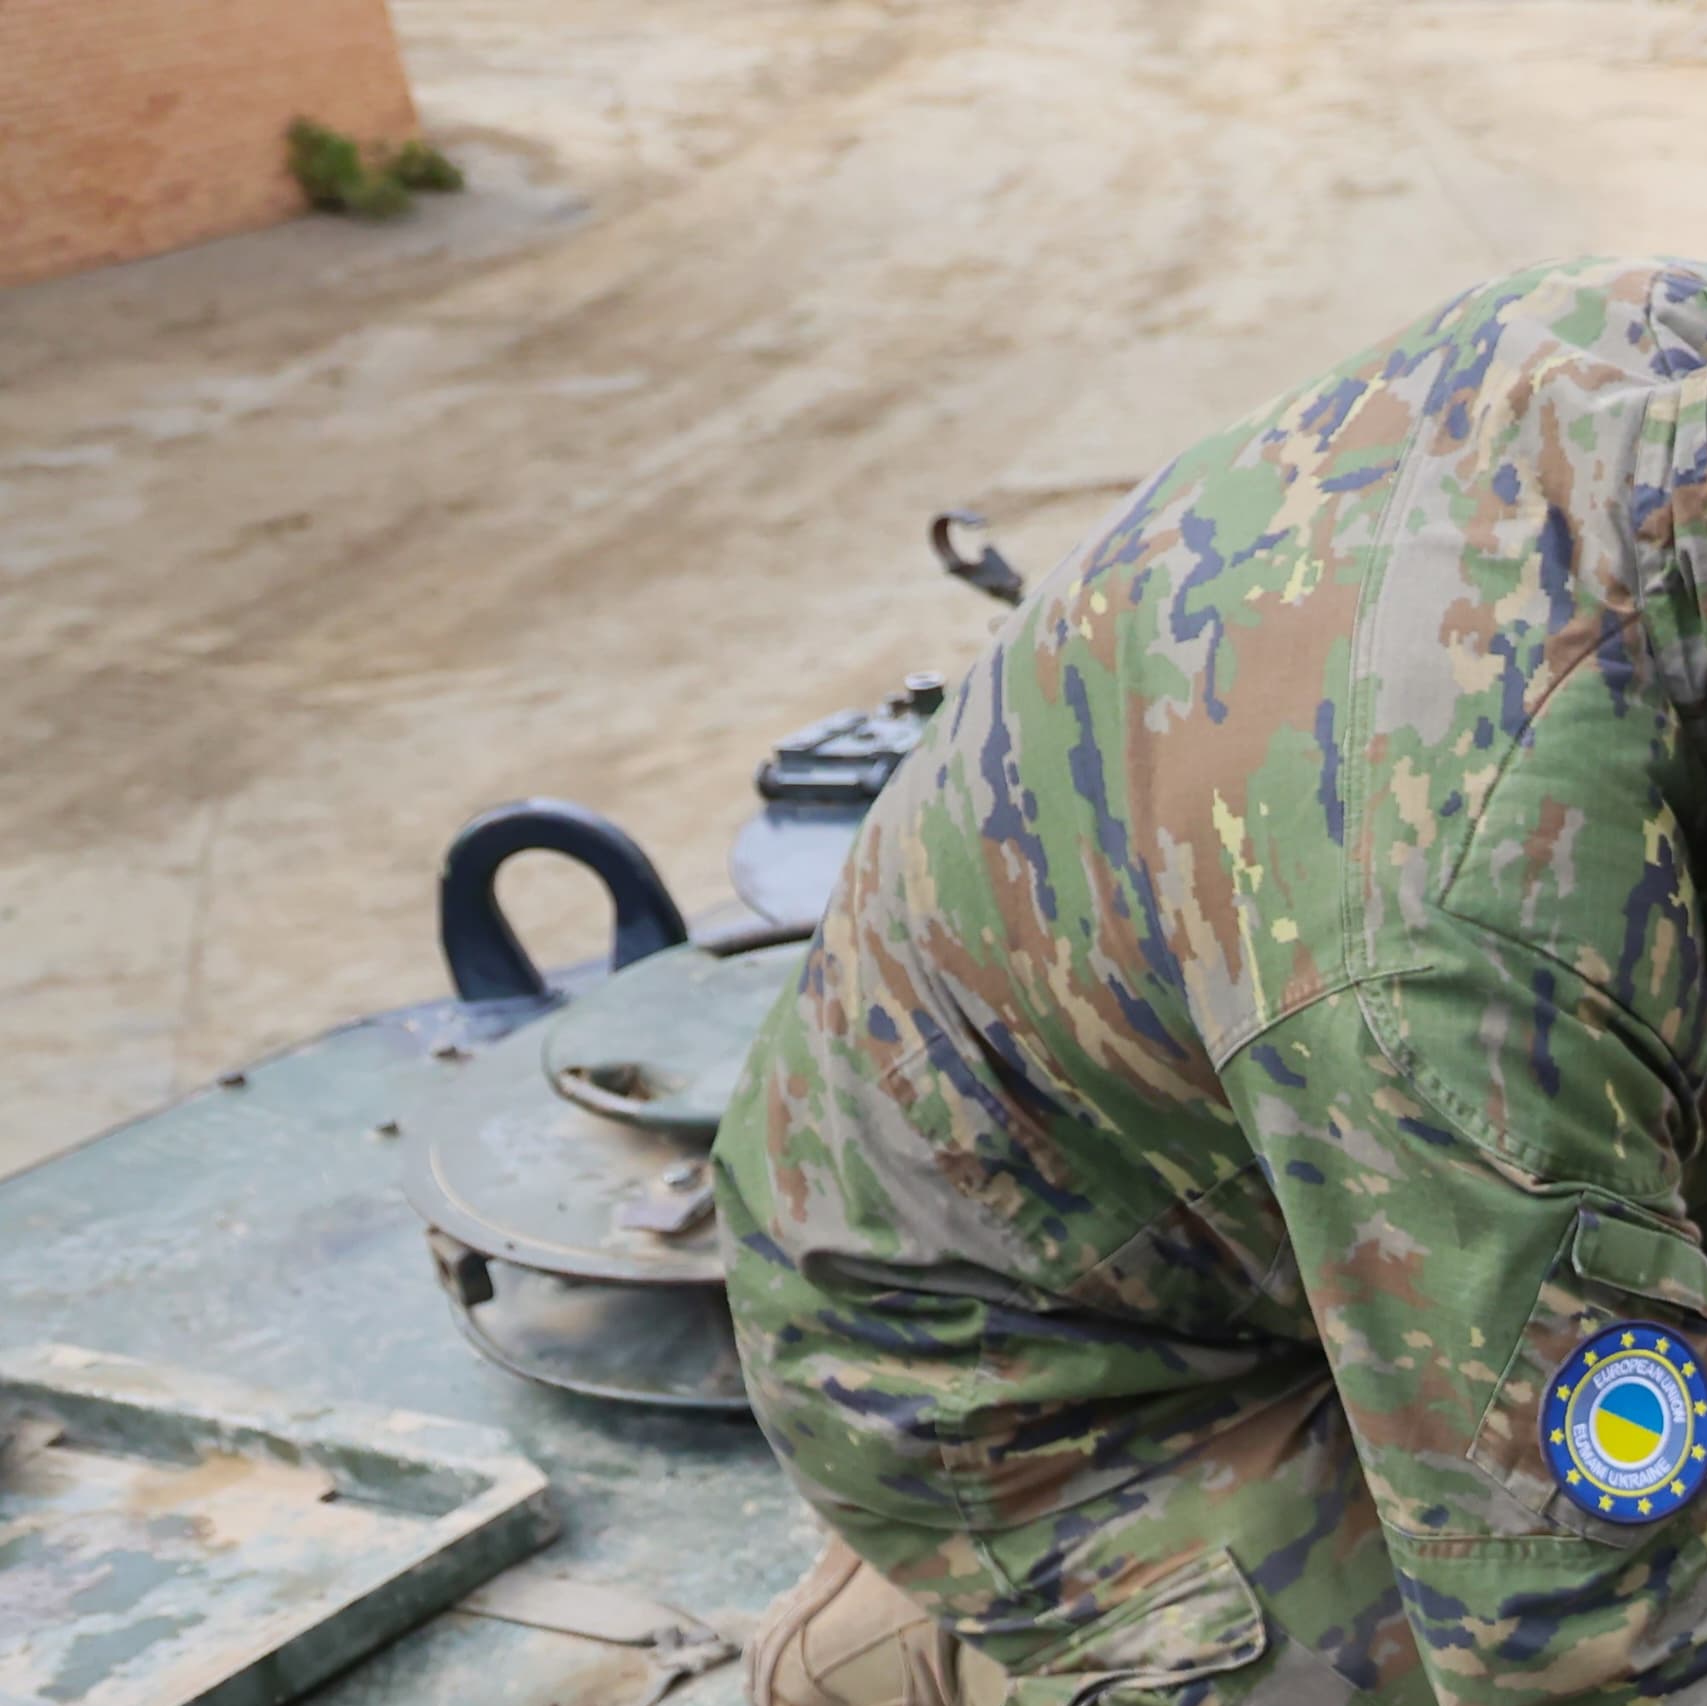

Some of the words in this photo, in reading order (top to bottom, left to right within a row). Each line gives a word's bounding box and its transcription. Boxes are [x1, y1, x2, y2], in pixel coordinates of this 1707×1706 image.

[1593, 1358, 1662, 1389] EUROPEAN
[1660, 1376, 1686, 1423] UNION
[1573, 1424, 1609, 1479] EUMAM
[1608, 1457, 1671, 1489] UKRAINE
